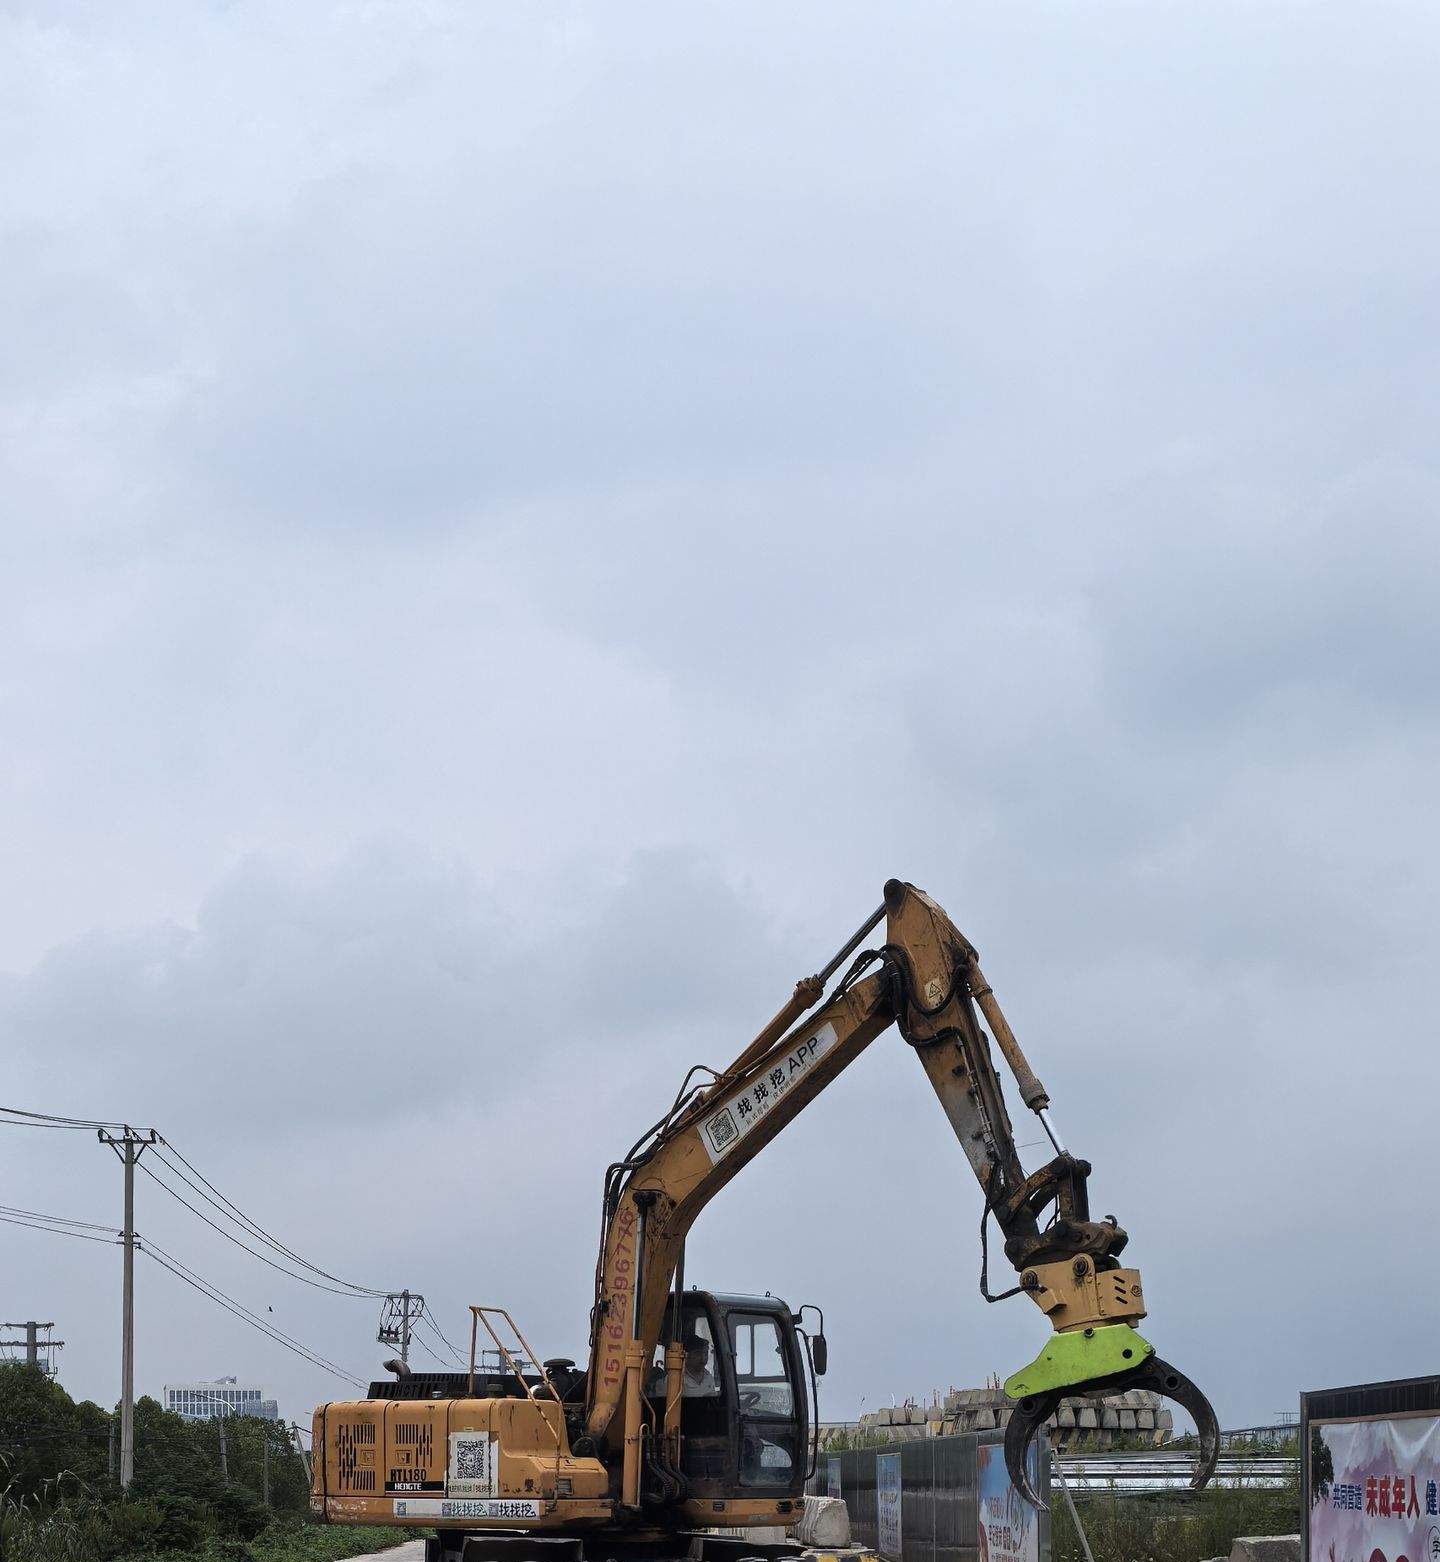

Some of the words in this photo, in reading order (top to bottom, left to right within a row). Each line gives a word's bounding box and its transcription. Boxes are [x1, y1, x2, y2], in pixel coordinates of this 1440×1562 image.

[737, 1068, 786, 1118] 找找挖
[788, 1037, 818, 1073] APP
[499, 1502, 537, 1518] 找找挖
